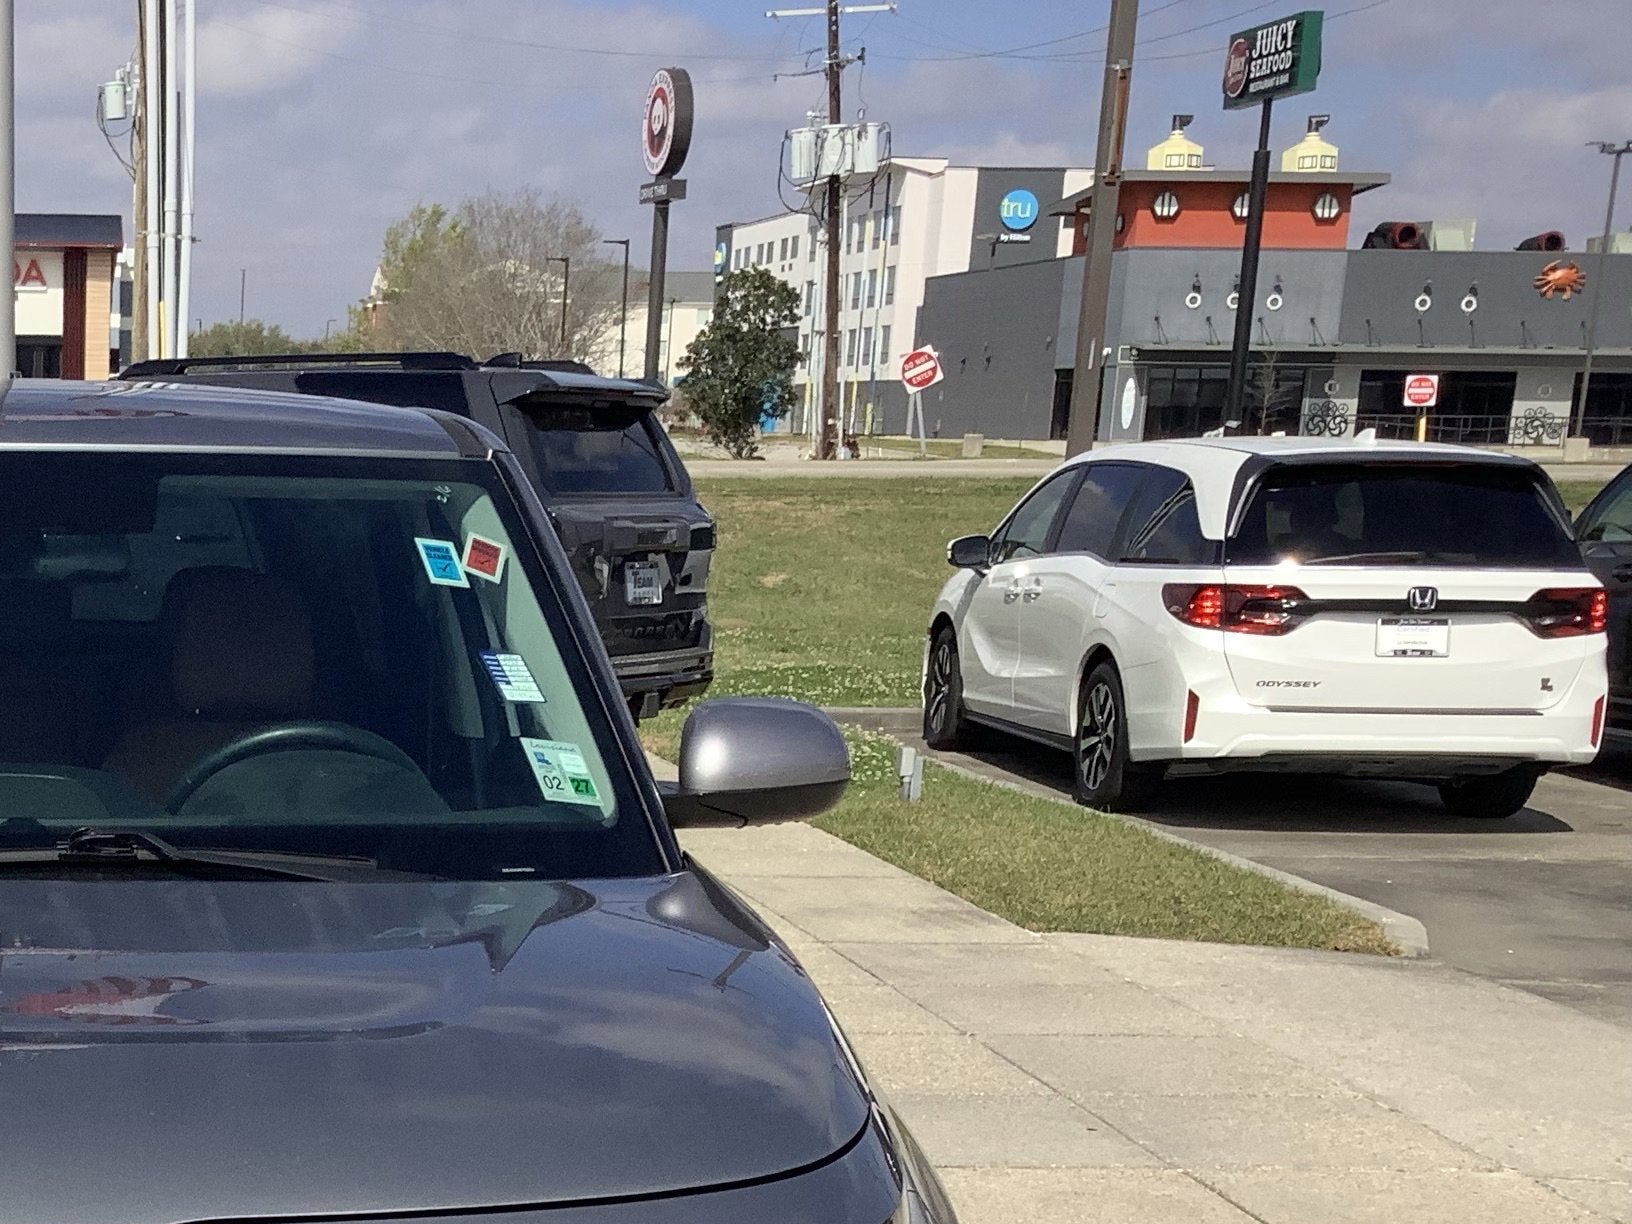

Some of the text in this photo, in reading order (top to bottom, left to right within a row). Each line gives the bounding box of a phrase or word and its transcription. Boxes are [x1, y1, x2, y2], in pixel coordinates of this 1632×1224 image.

[1251, 20, 1297, 59] JUICY
[1249, 50, 1293, 79] SEAFOOD
[1000, 198, 1031, 218] tru
[904, 354, 929, 371] DO NOT
[911, 370, 933, 385] ENTER
[1256, 680, 1322, 688] ODYSSEY
[543, 775, 590, 793] 02 27
